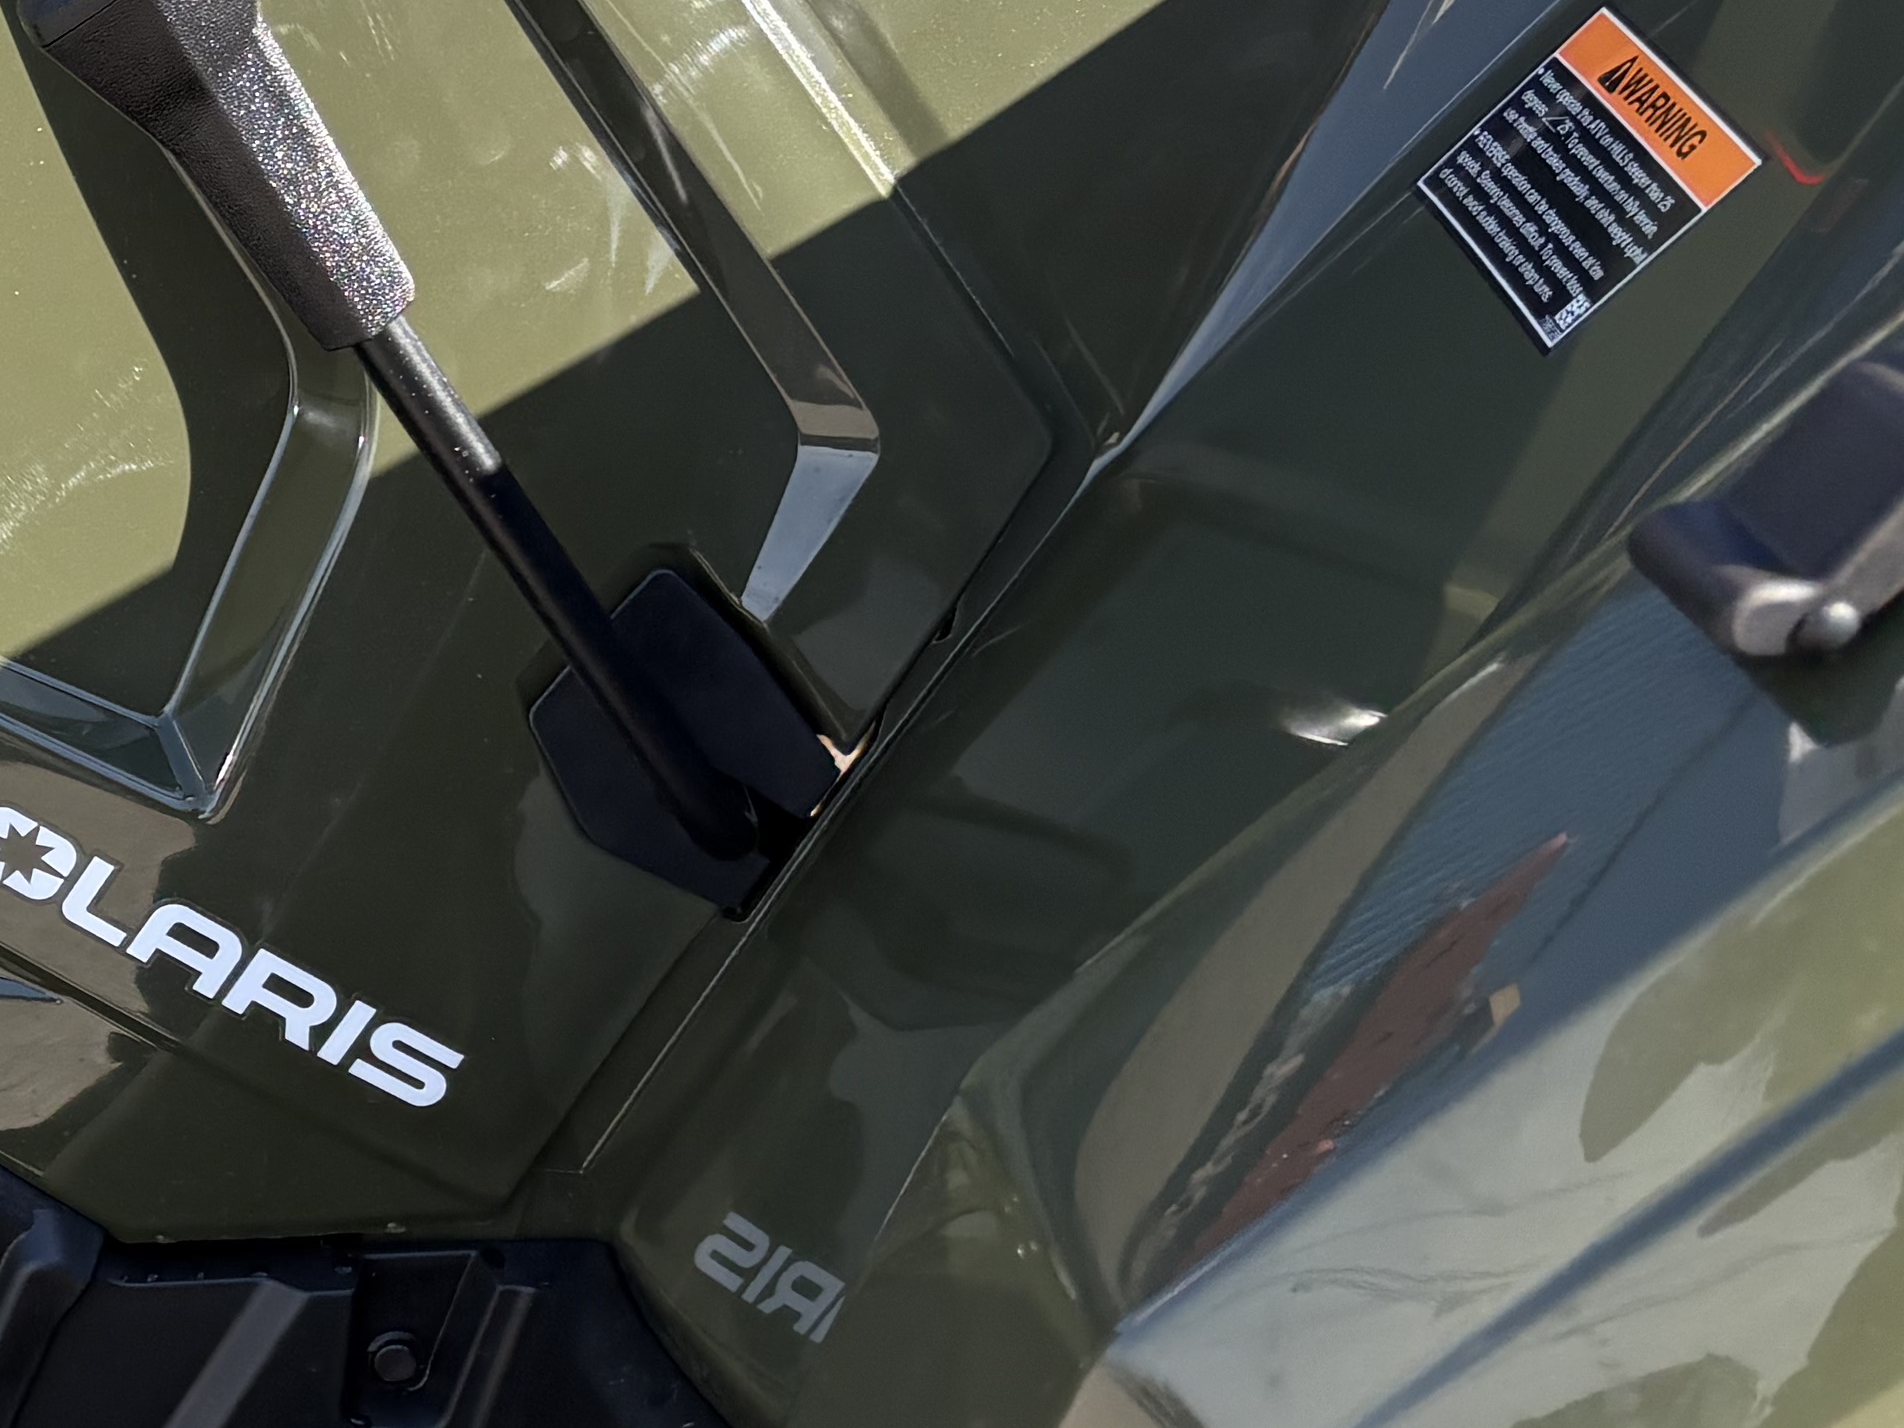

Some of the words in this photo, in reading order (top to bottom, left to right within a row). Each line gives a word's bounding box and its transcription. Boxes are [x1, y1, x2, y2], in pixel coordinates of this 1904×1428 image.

[1586, 118, 1609, 138] ATV
[1607, 140, 1633, 166] HILLS
[1617, 67, 1706, 160] WARNING
